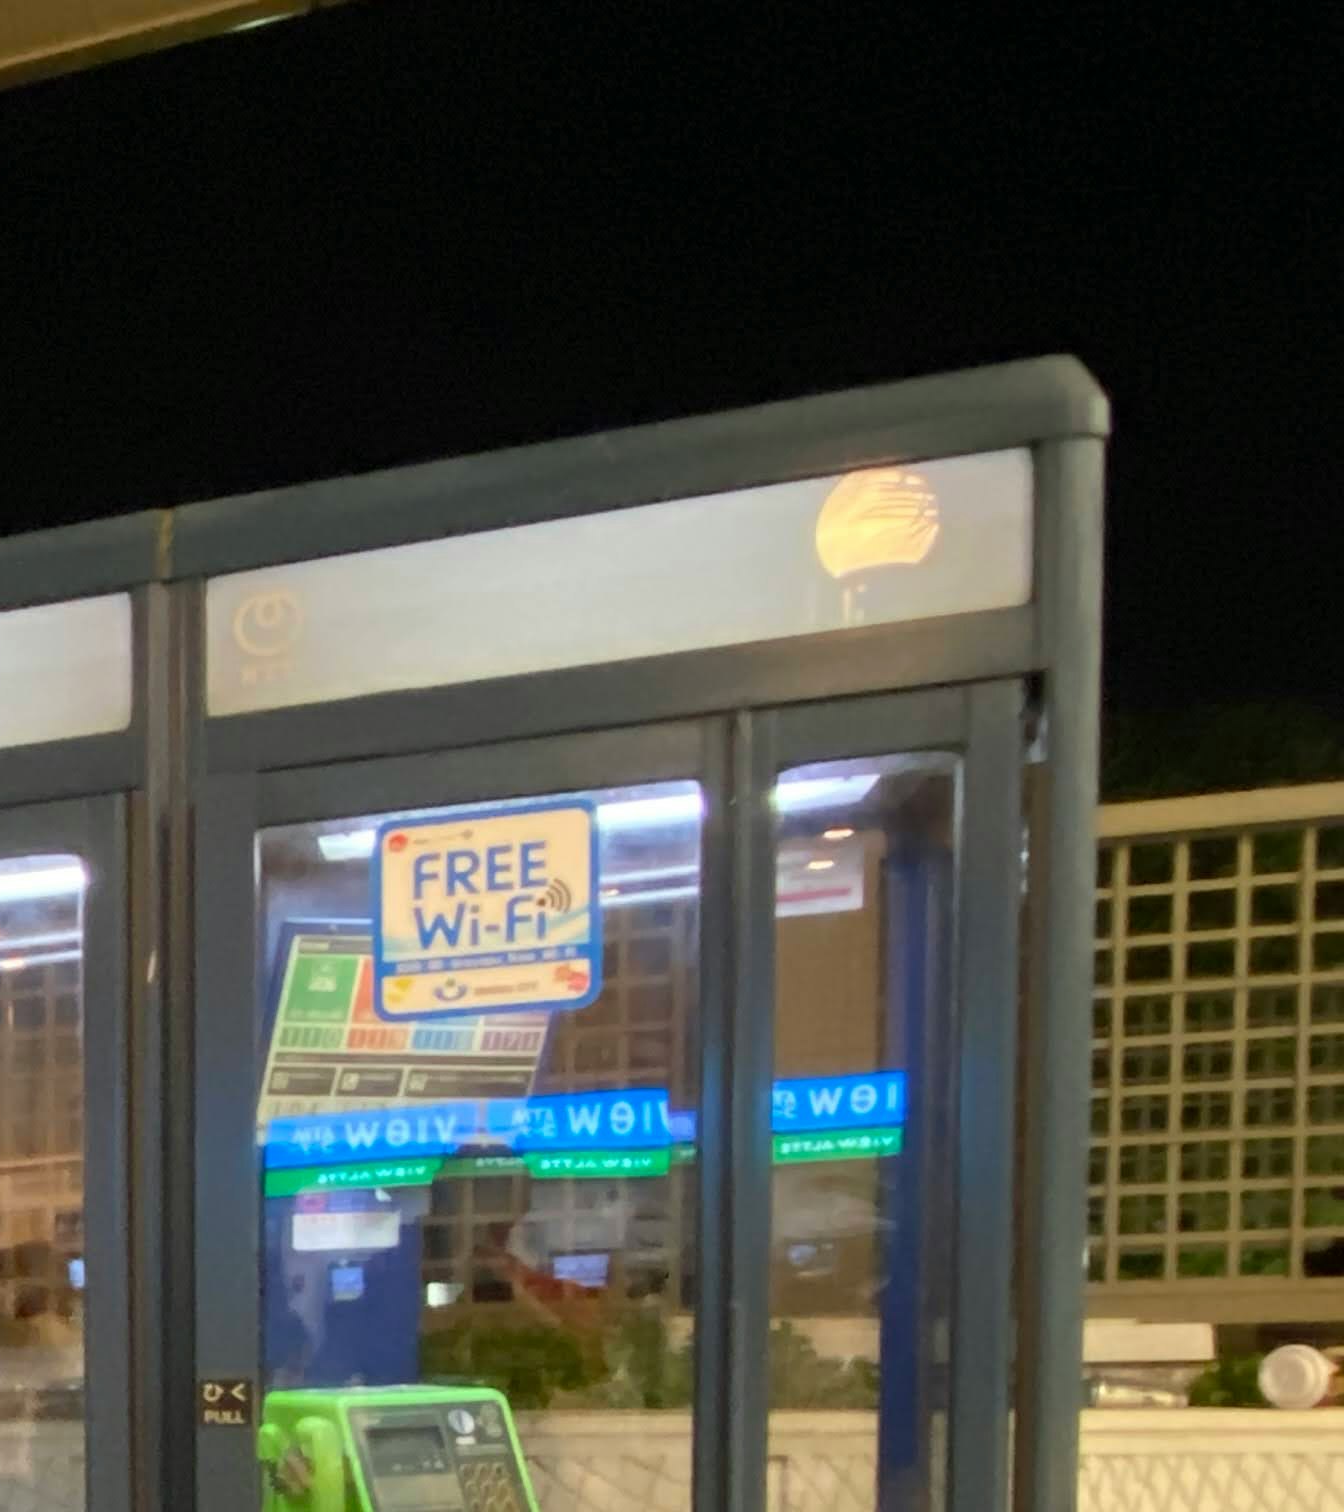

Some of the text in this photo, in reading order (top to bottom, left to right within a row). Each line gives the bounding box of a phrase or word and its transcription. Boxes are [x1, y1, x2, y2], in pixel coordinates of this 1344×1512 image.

[413, 841, 547, 900] FREE
[413, 895, 546, 949] Wi-Fi
[204, 1410, 246, 1424] PULL
